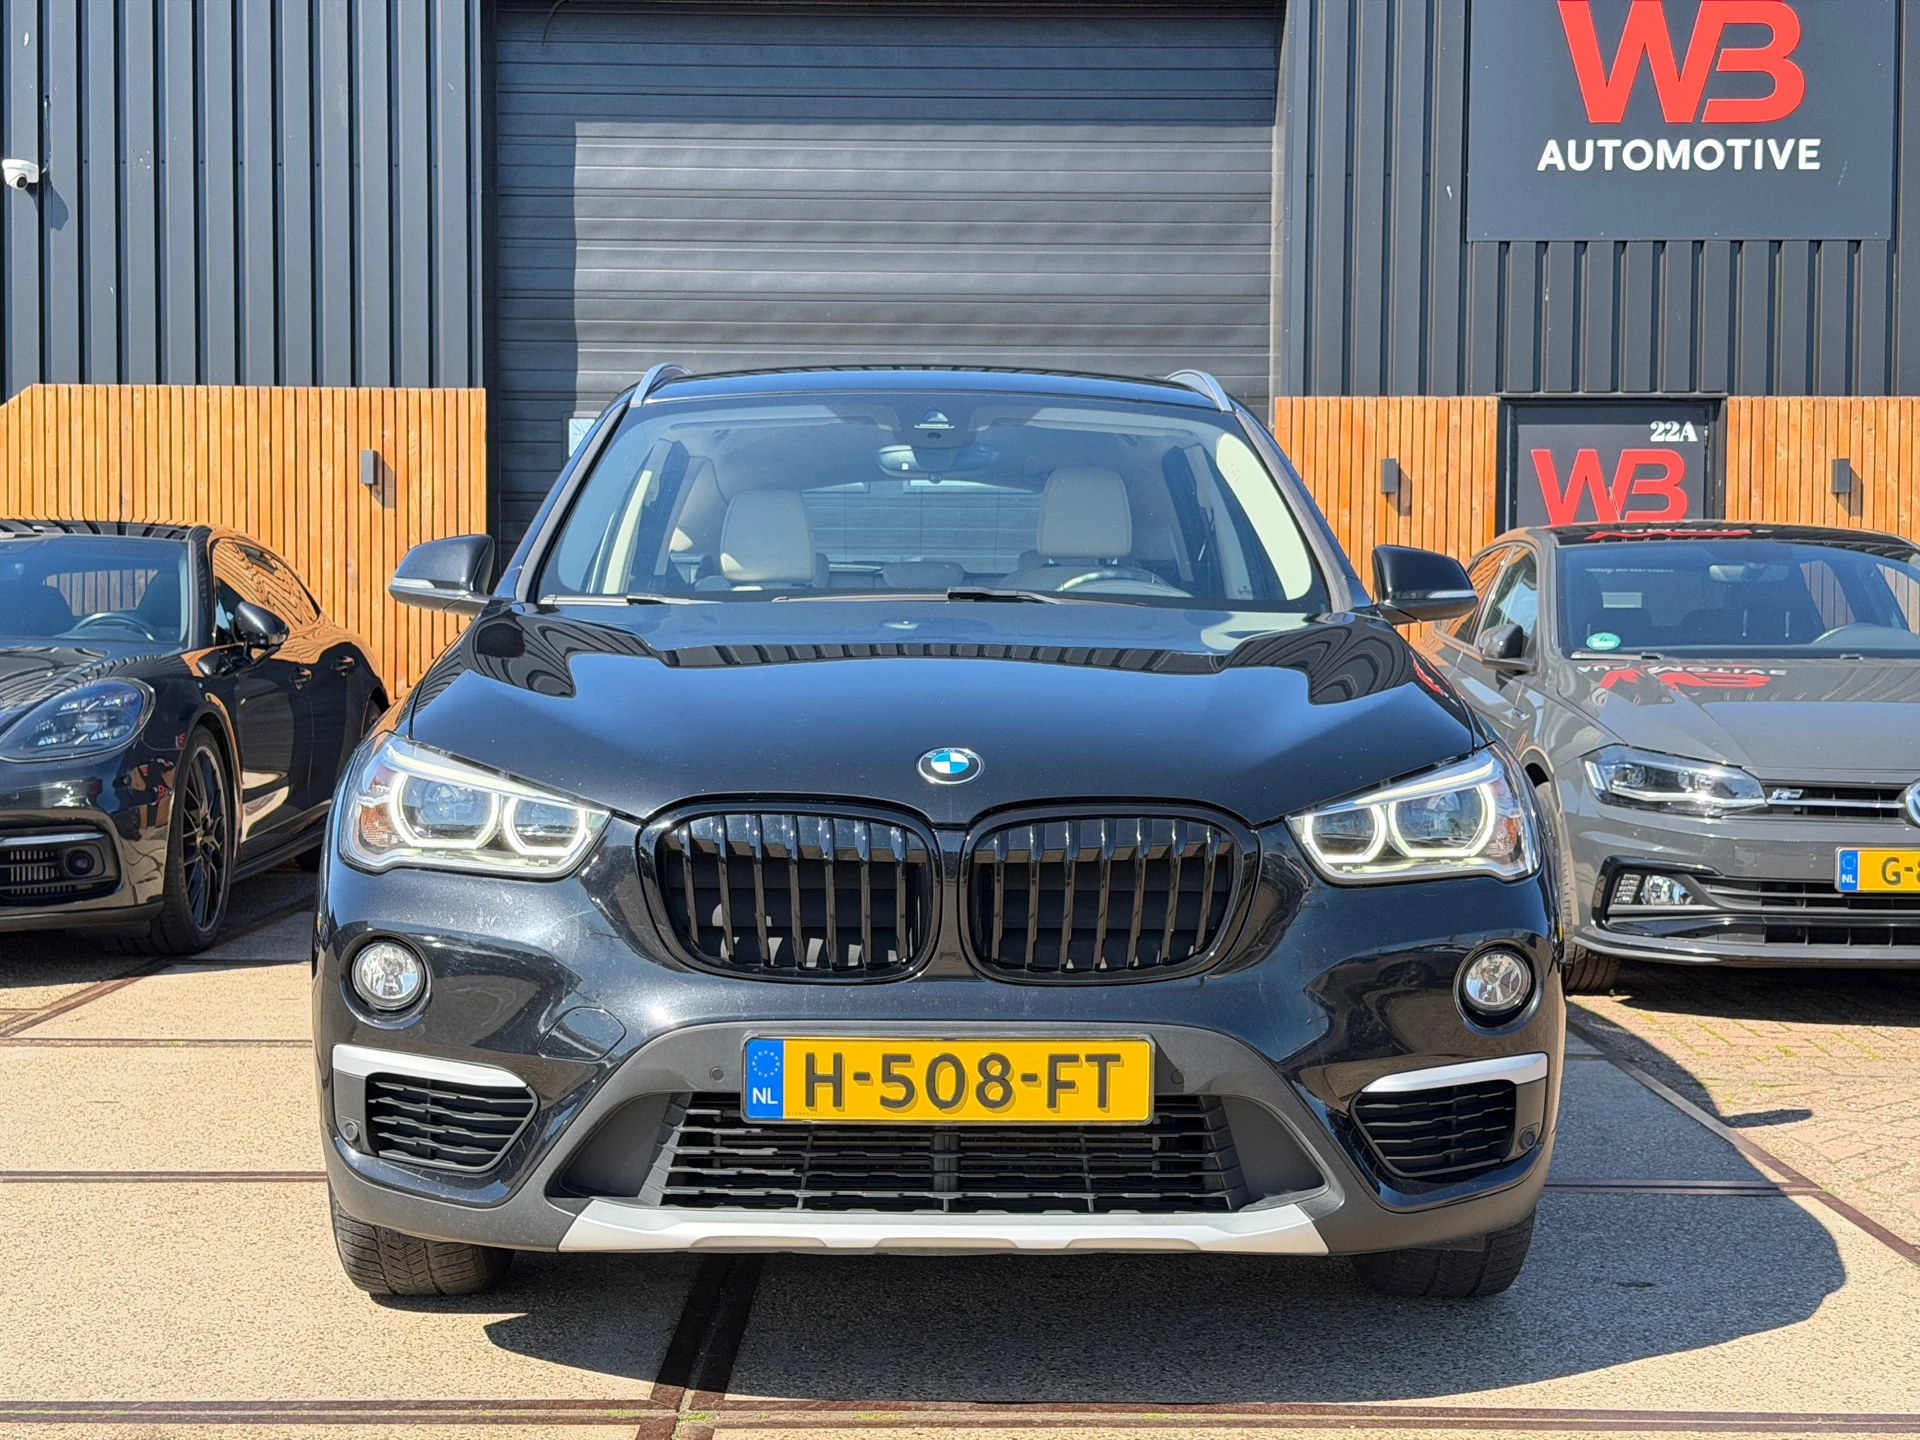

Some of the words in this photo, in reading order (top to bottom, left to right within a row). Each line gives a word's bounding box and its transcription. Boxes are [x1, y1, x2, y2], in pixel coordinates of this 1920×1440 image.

[1557, 0, 1806, 123] WB
[1536, 138, 1822, 172] AUTOMOTIVE
[1650, 420, 1698, 442] 22A
[1530, 449, 1688, 526] WB
[1841, 874, 1856, 884] NL
[1881, 856, 1920, 886] G-
[752, 1087, 778, 1104] NL
[804, 1052, 1122, 1110] H-508-FT
